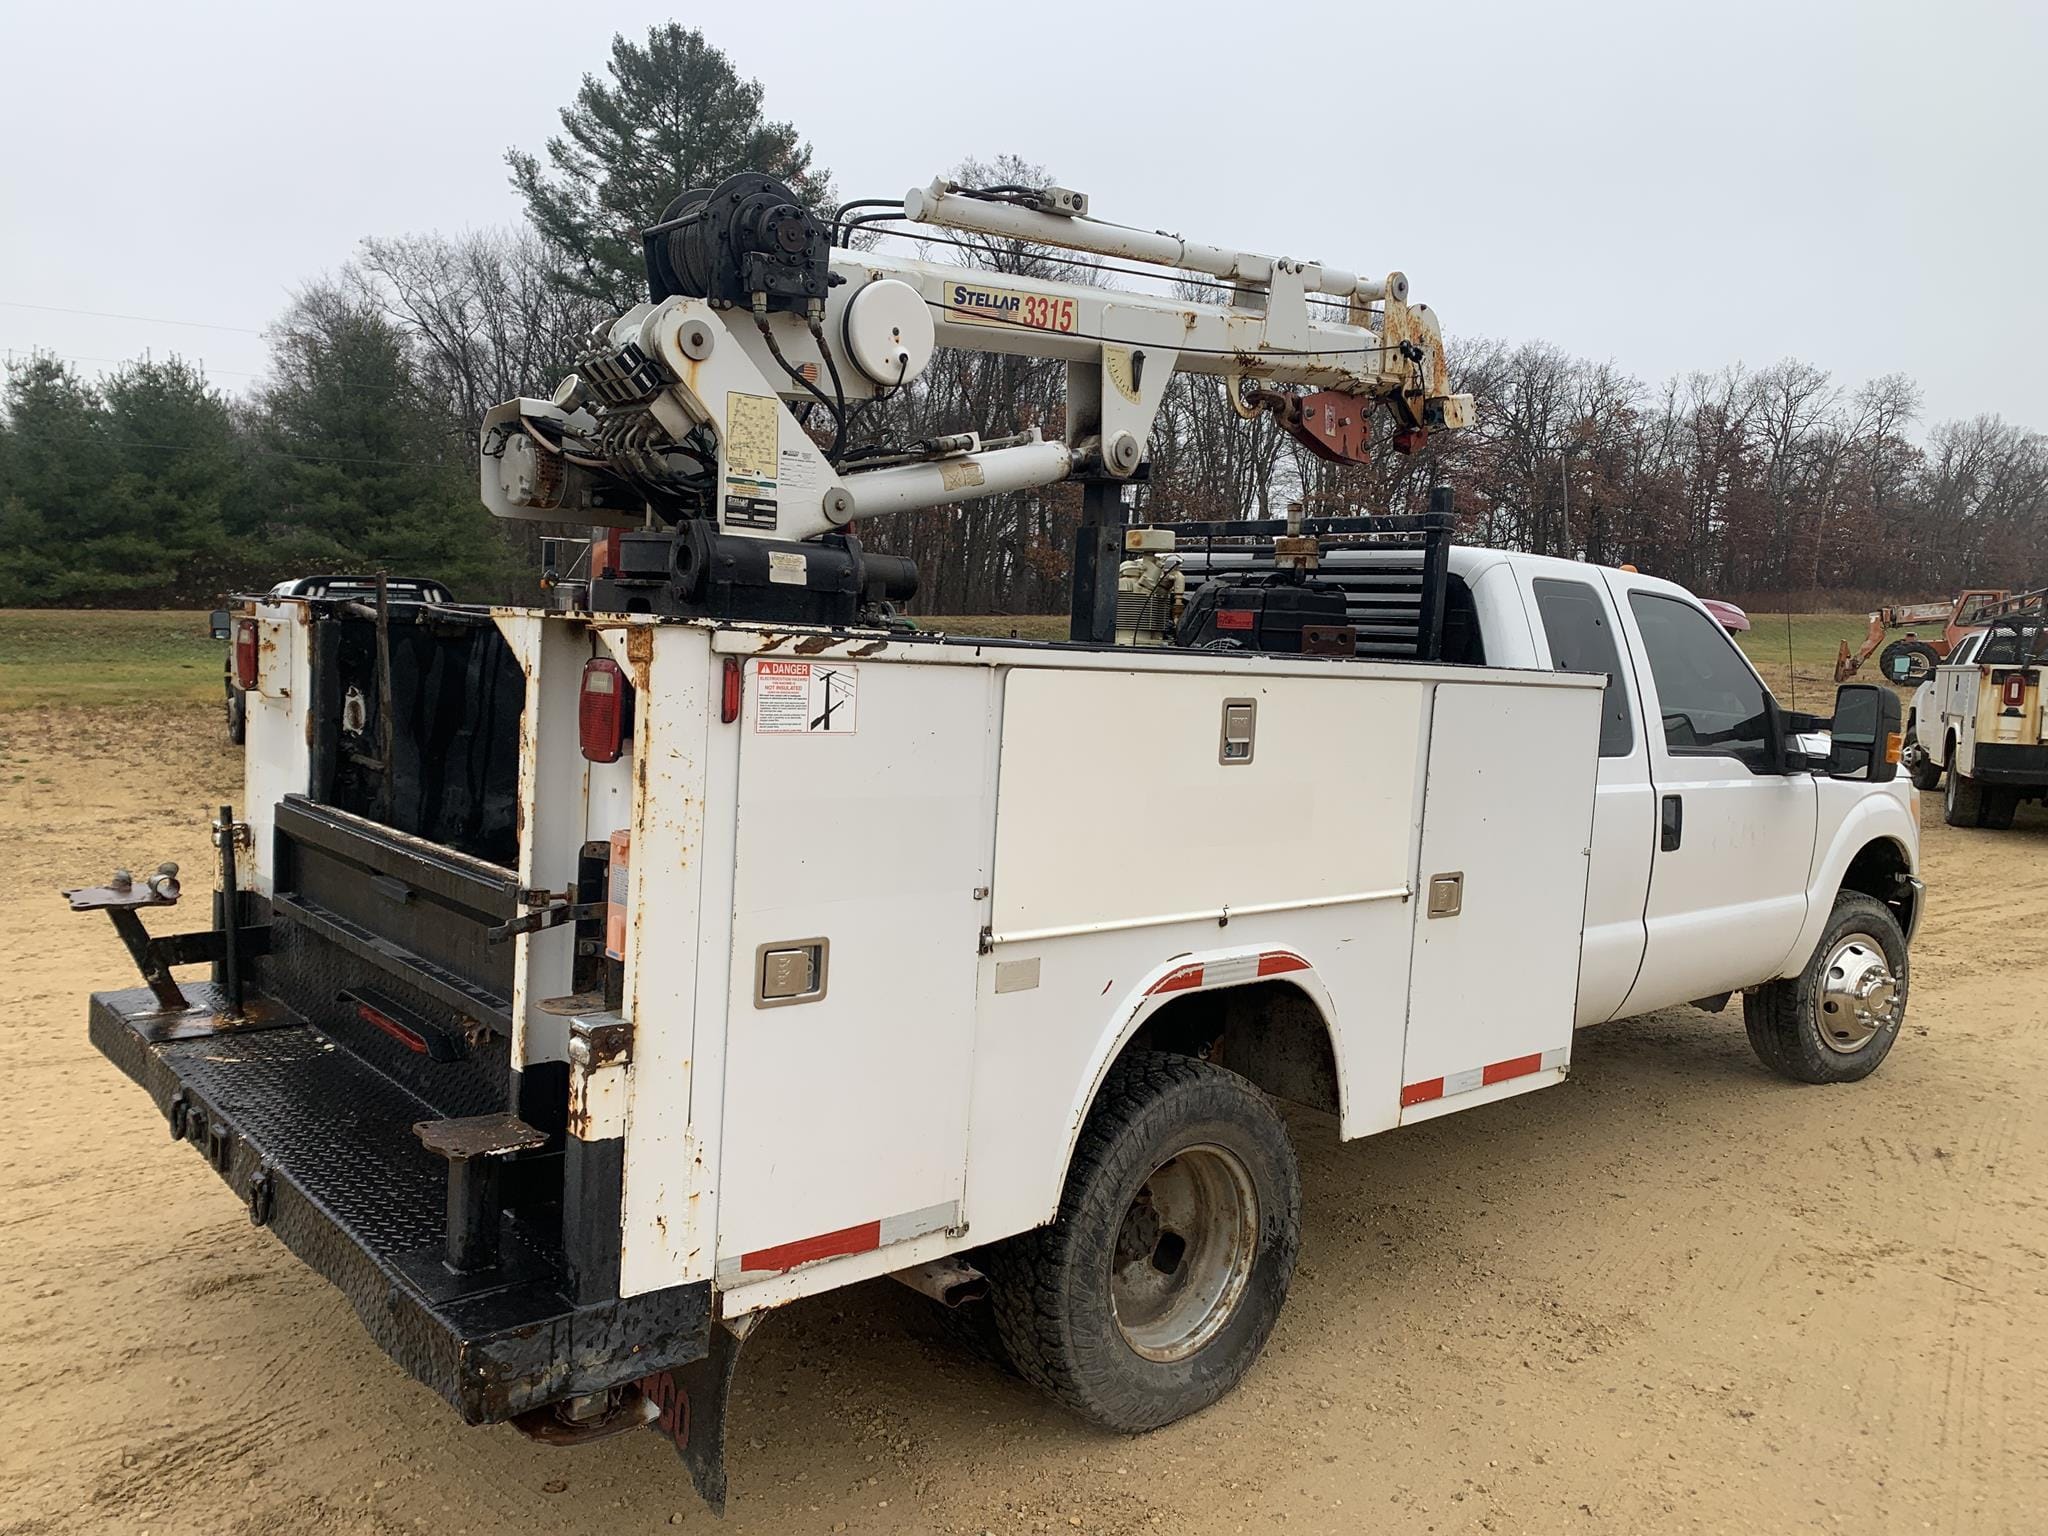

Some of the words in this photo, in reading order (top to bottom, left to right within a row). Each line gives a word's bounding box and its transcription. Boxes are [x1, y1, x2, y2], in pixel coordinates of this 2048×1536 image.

[953, 286, 1020, 311] STELLAR
[1023, 296, 1073, 332] 3315
[772, 663, 808, 675] DANGER
